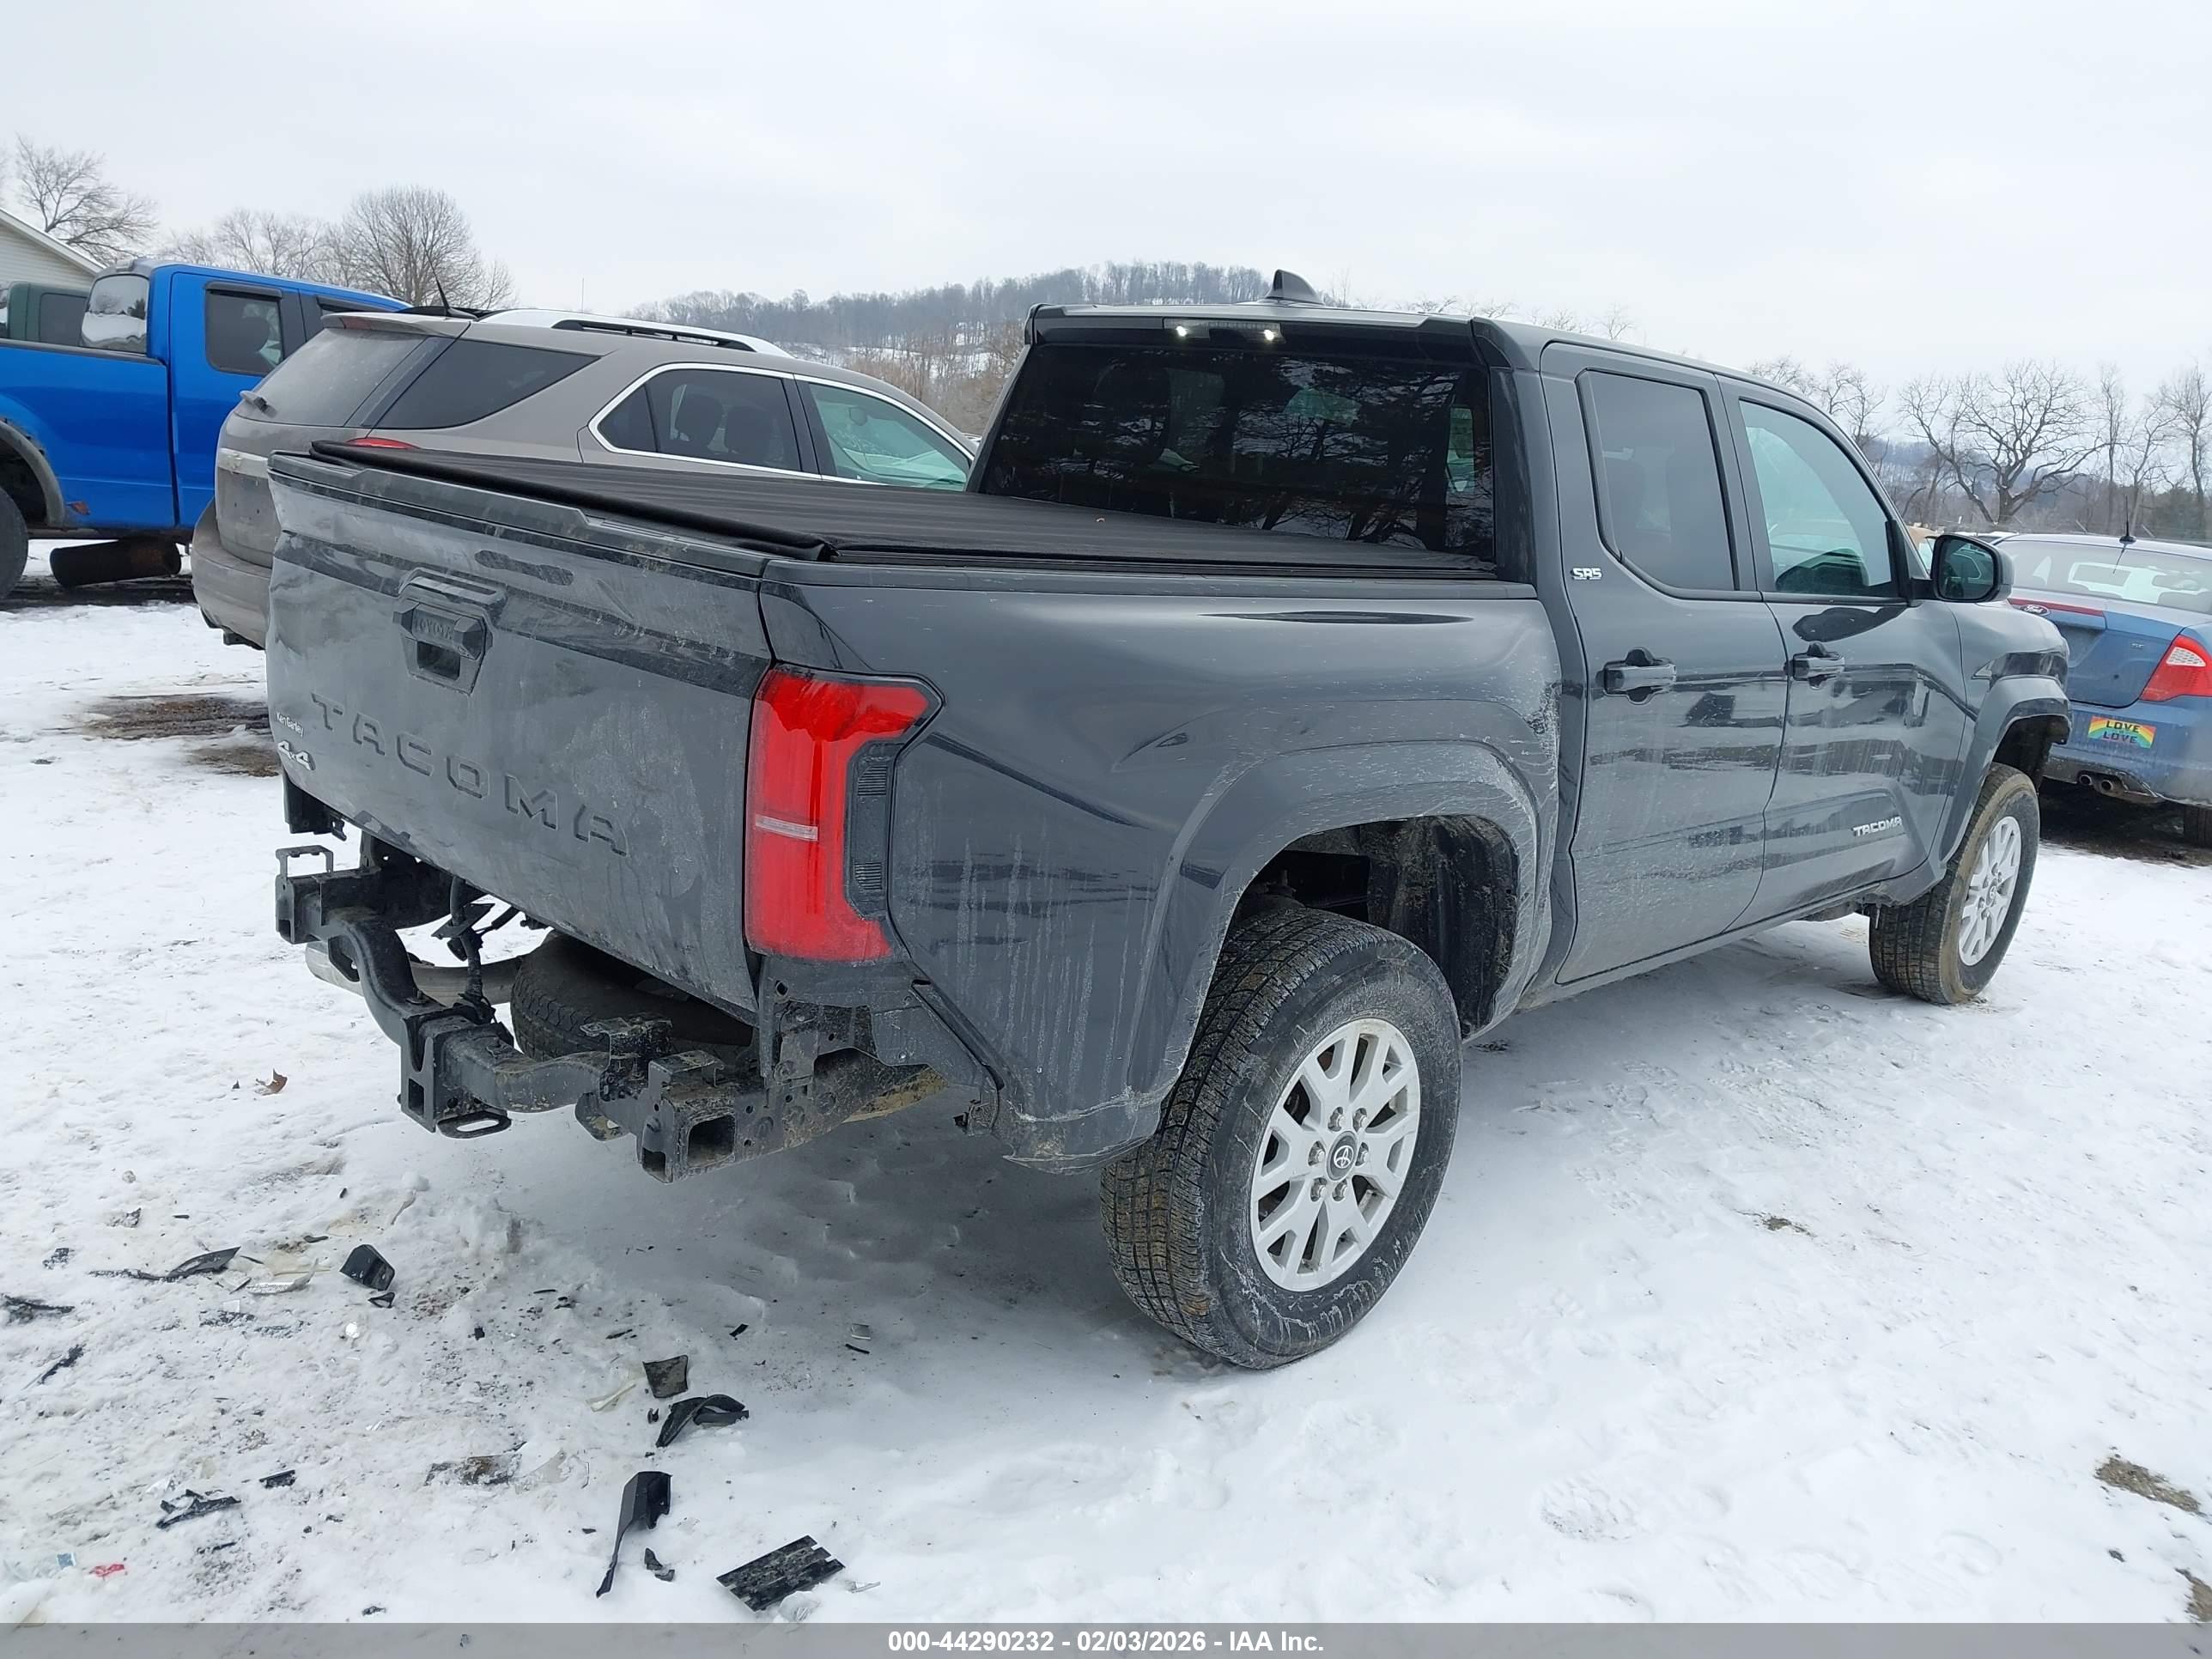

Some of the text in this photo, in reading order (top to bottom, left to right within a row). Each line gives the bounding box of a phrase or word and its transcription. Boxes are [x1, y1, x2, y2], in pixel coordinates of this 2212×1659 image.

[1571, 567, 1602, 580] SR5
[2106, 720, 2141, 733] LOVE
[2102, 731, 2137, 744] LOVE
[311, 692, 630, 857] TACOMA
[1852, 816, 1903, 837] TACOMA
